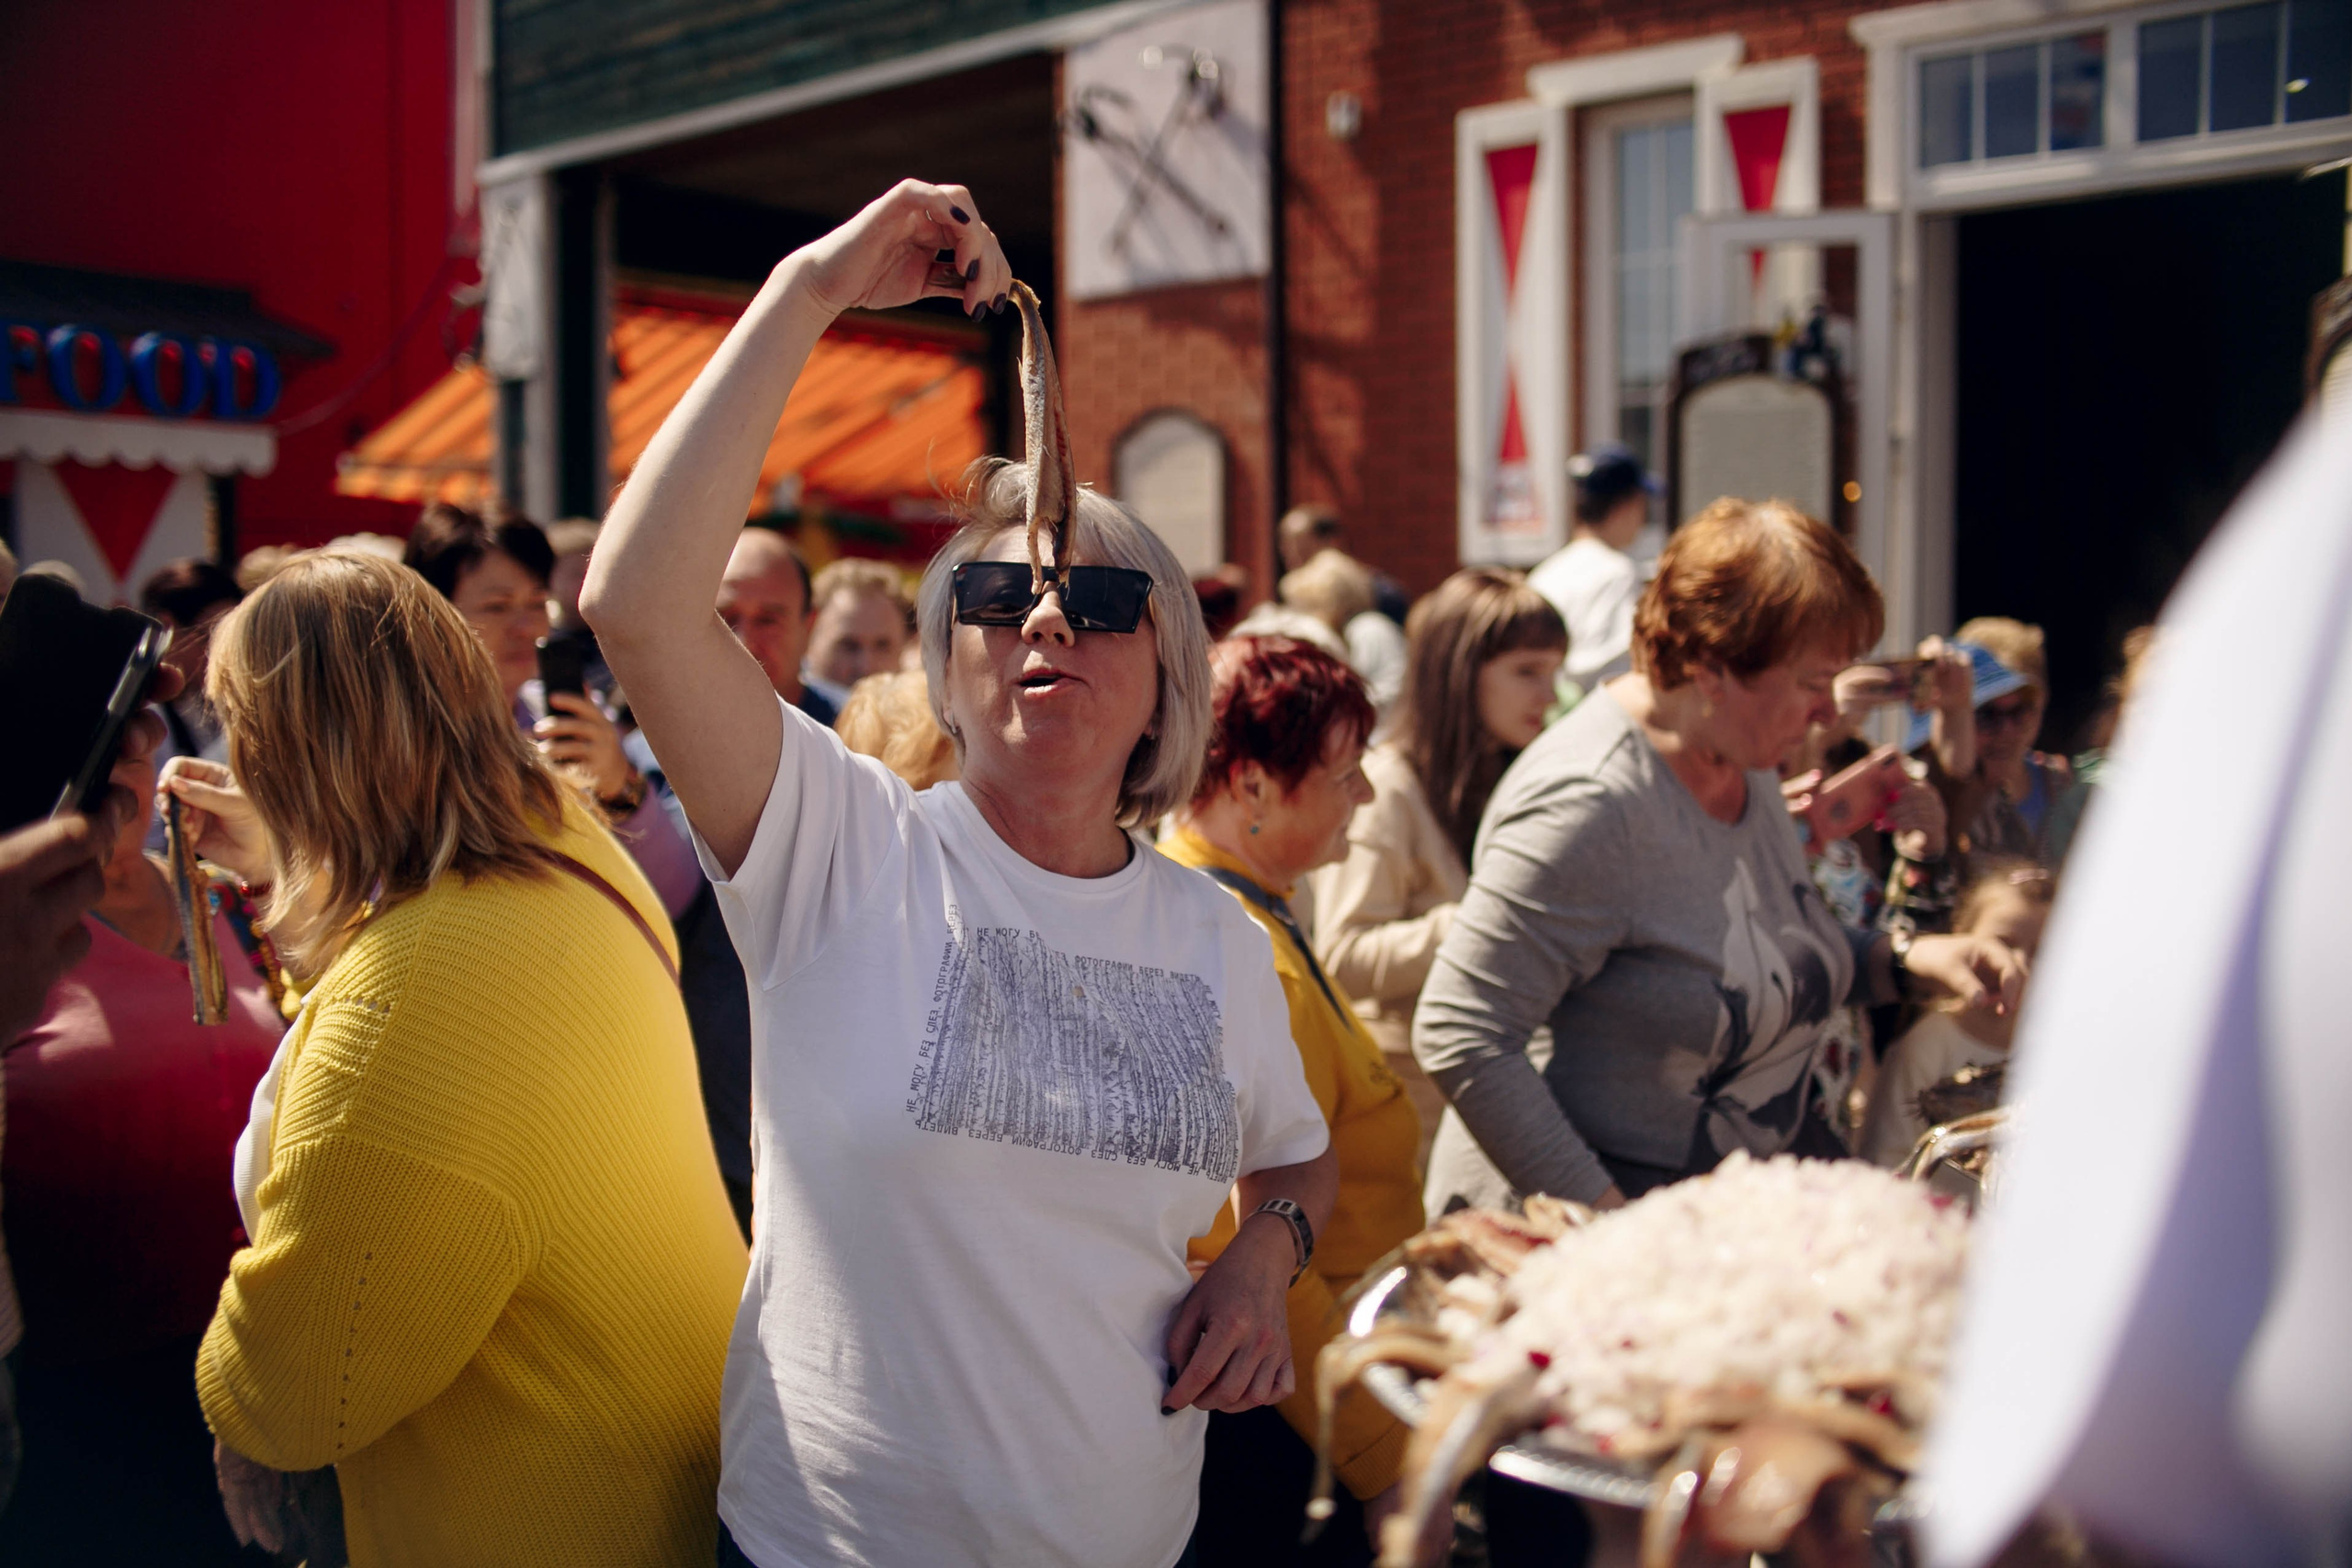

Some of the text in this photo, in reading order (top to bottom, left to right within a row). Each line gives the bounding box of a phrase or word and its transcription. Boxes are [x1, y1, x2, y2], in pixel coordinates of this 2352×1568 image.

[0, 318, 281, 423] FOOD
[947, 904, 957, 933] БЕРЕЗ
[977, 927, 989, 937] НЕ
[995, 928, 1020, 938] МОГУ
[1075, 954, 1133, 971] ФОТОГРАФИИ
[1138, 965, 1164, 977] БЕРЕЗ
[933, 942, 953, 1002] ФОТОГРАФИИ
[919, 1040, 932, 1057] БЕЗ
[910, 1064, 924, 1091] МОГУ
[906, 1099, 917, 1112] НЕ
[915, 1119, 958, 1135] ВИДЕТЬ
[967, 1128, 1003, 1143] БЕРЕЗ
[1012, 1134, 1082, 1156] ФОТОГРАФИИ
[1091, 1149, 1118, 1161] СЛЕЗ
[1126, 1155, 1147, 1166] БЕЗ
[1154, 1160, 1181, 1172] МОГУ
[1187, 1165, 1201, 1176] НЕ
